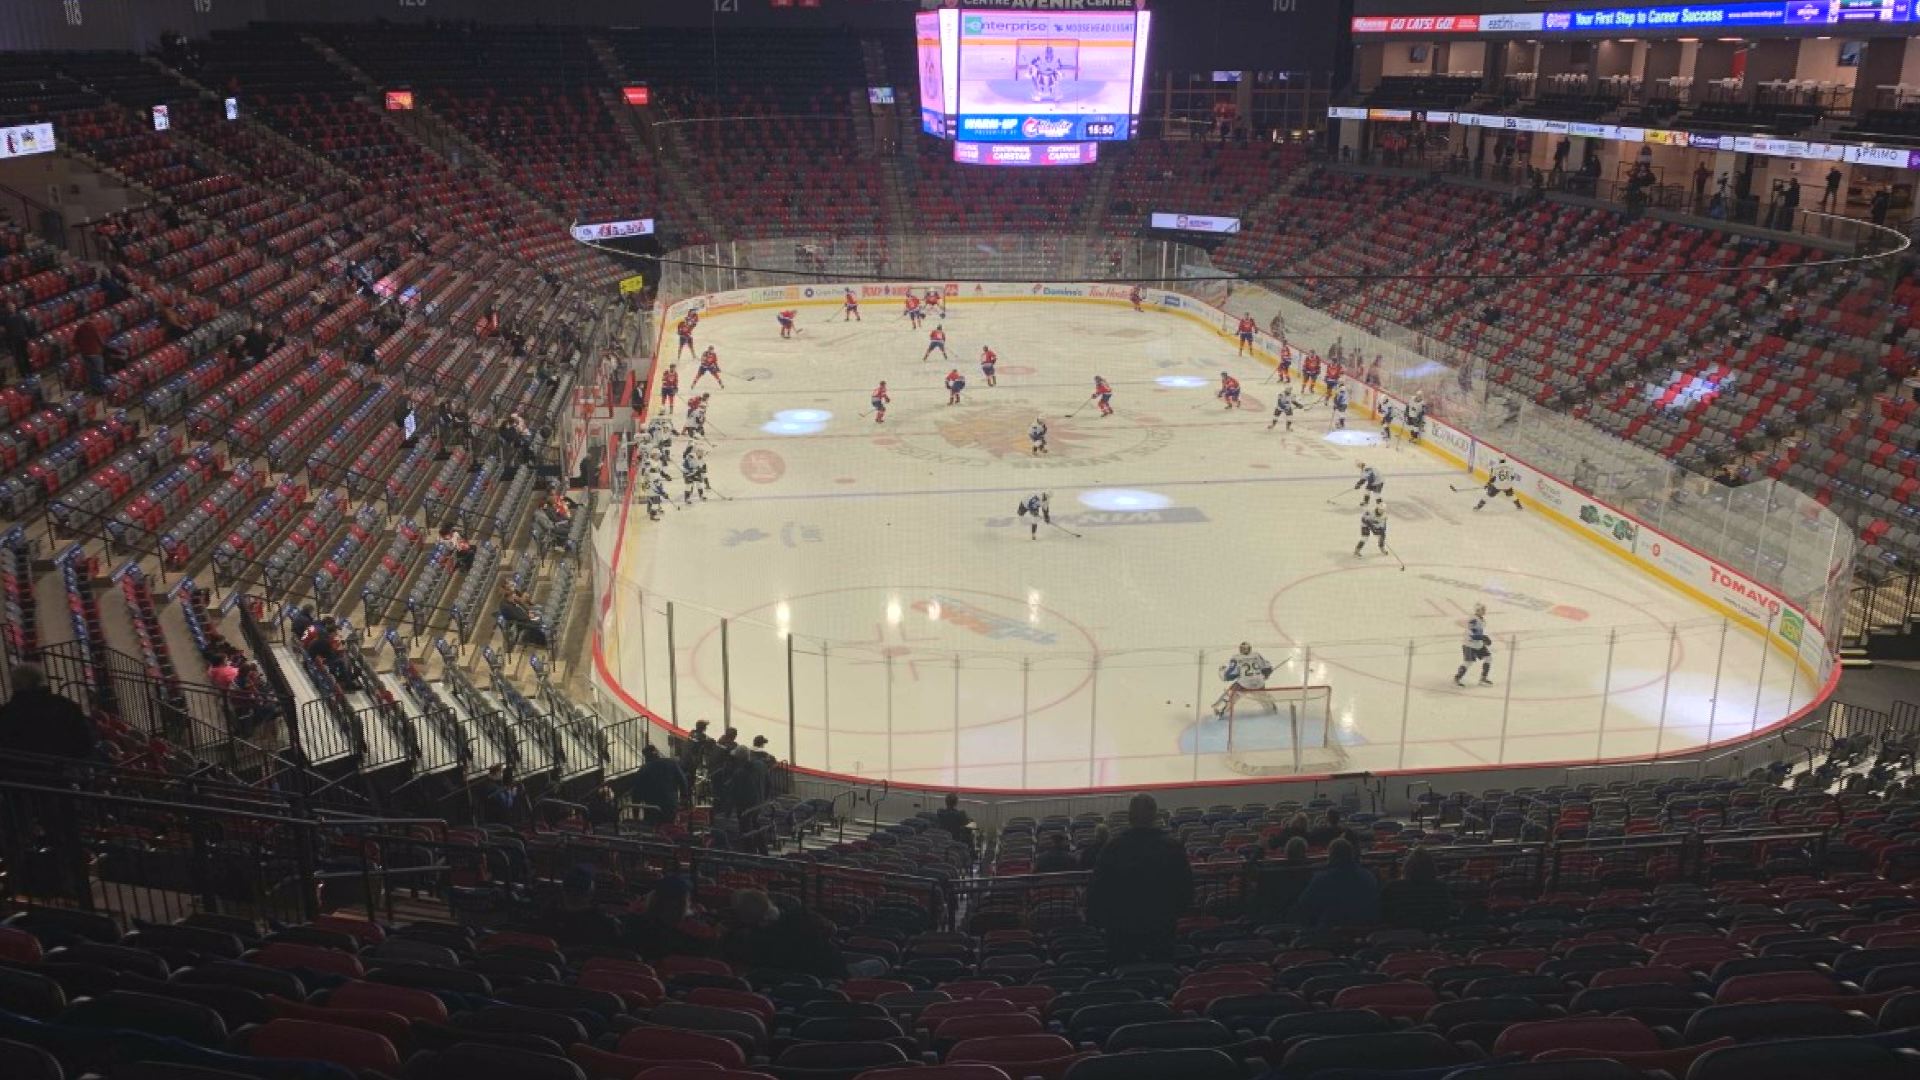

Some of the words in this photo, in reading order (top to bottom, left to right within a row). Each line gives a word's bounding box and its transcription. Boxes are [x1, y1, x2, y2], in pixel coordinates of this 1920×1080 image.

[1615, 11, 1636, 27] Step
[1637, 11, 1646, 24] to
[1648, 9, 1680, 23] Career
[1681, 8, 1724, 23] Success
